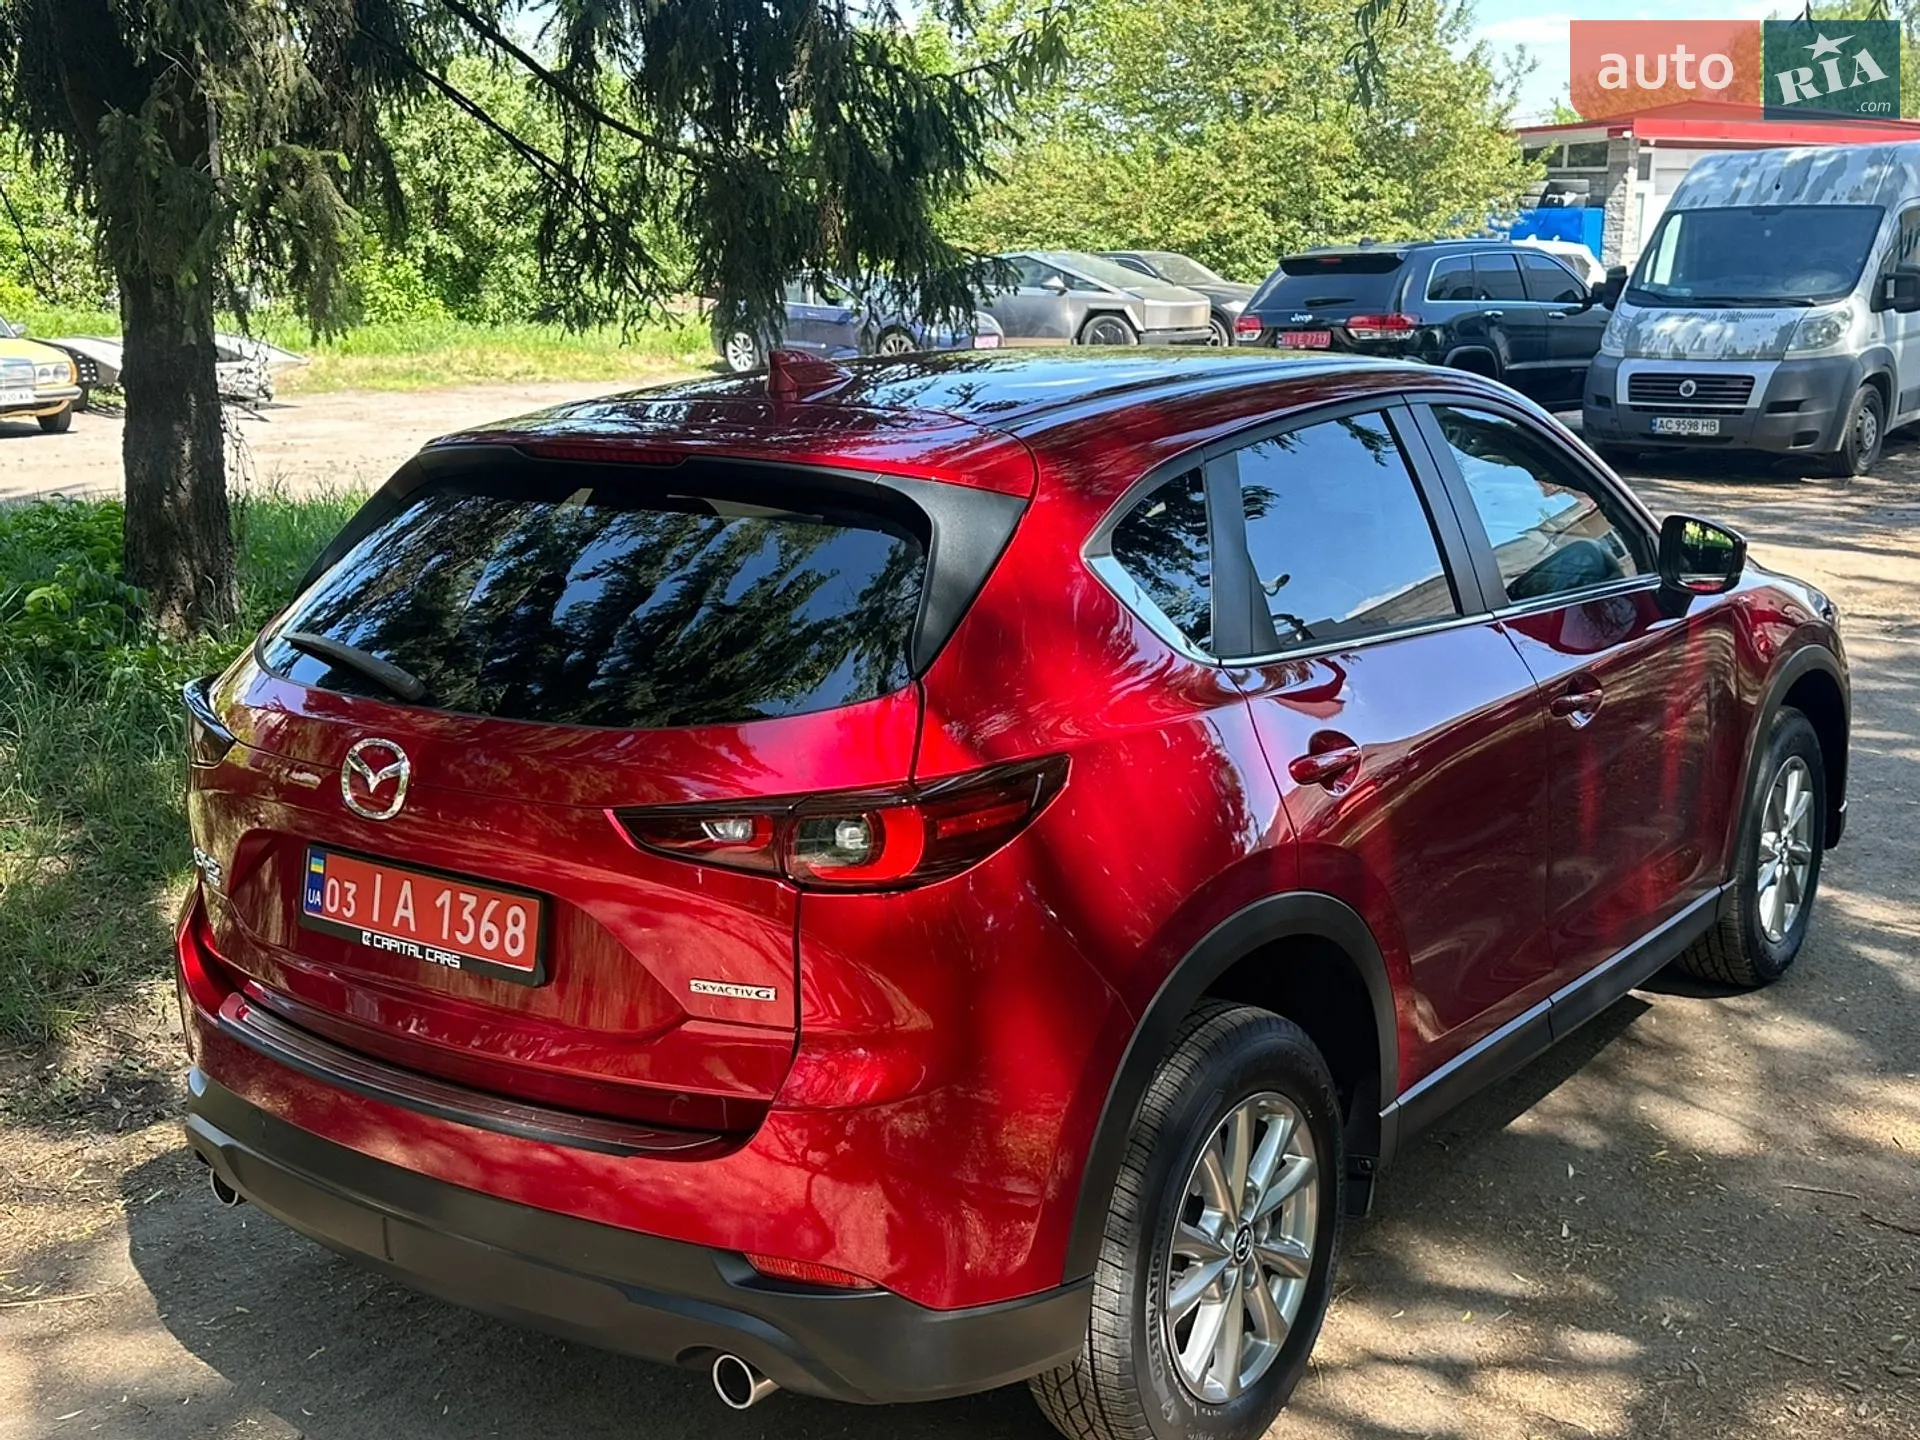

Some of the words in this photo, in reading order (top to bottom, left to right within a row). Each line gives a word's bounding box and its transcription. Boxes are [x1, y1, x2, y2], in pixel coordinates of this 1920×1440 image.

[308, 888, 322, 906] UA
[325, 878, 357, 918] 03
[371, 872, 417, 932] IA
[435, 889, 527, 958] 1368
[373, 934, 424, 959] CAPITAL
[425, 947, 461, 969] CARS
